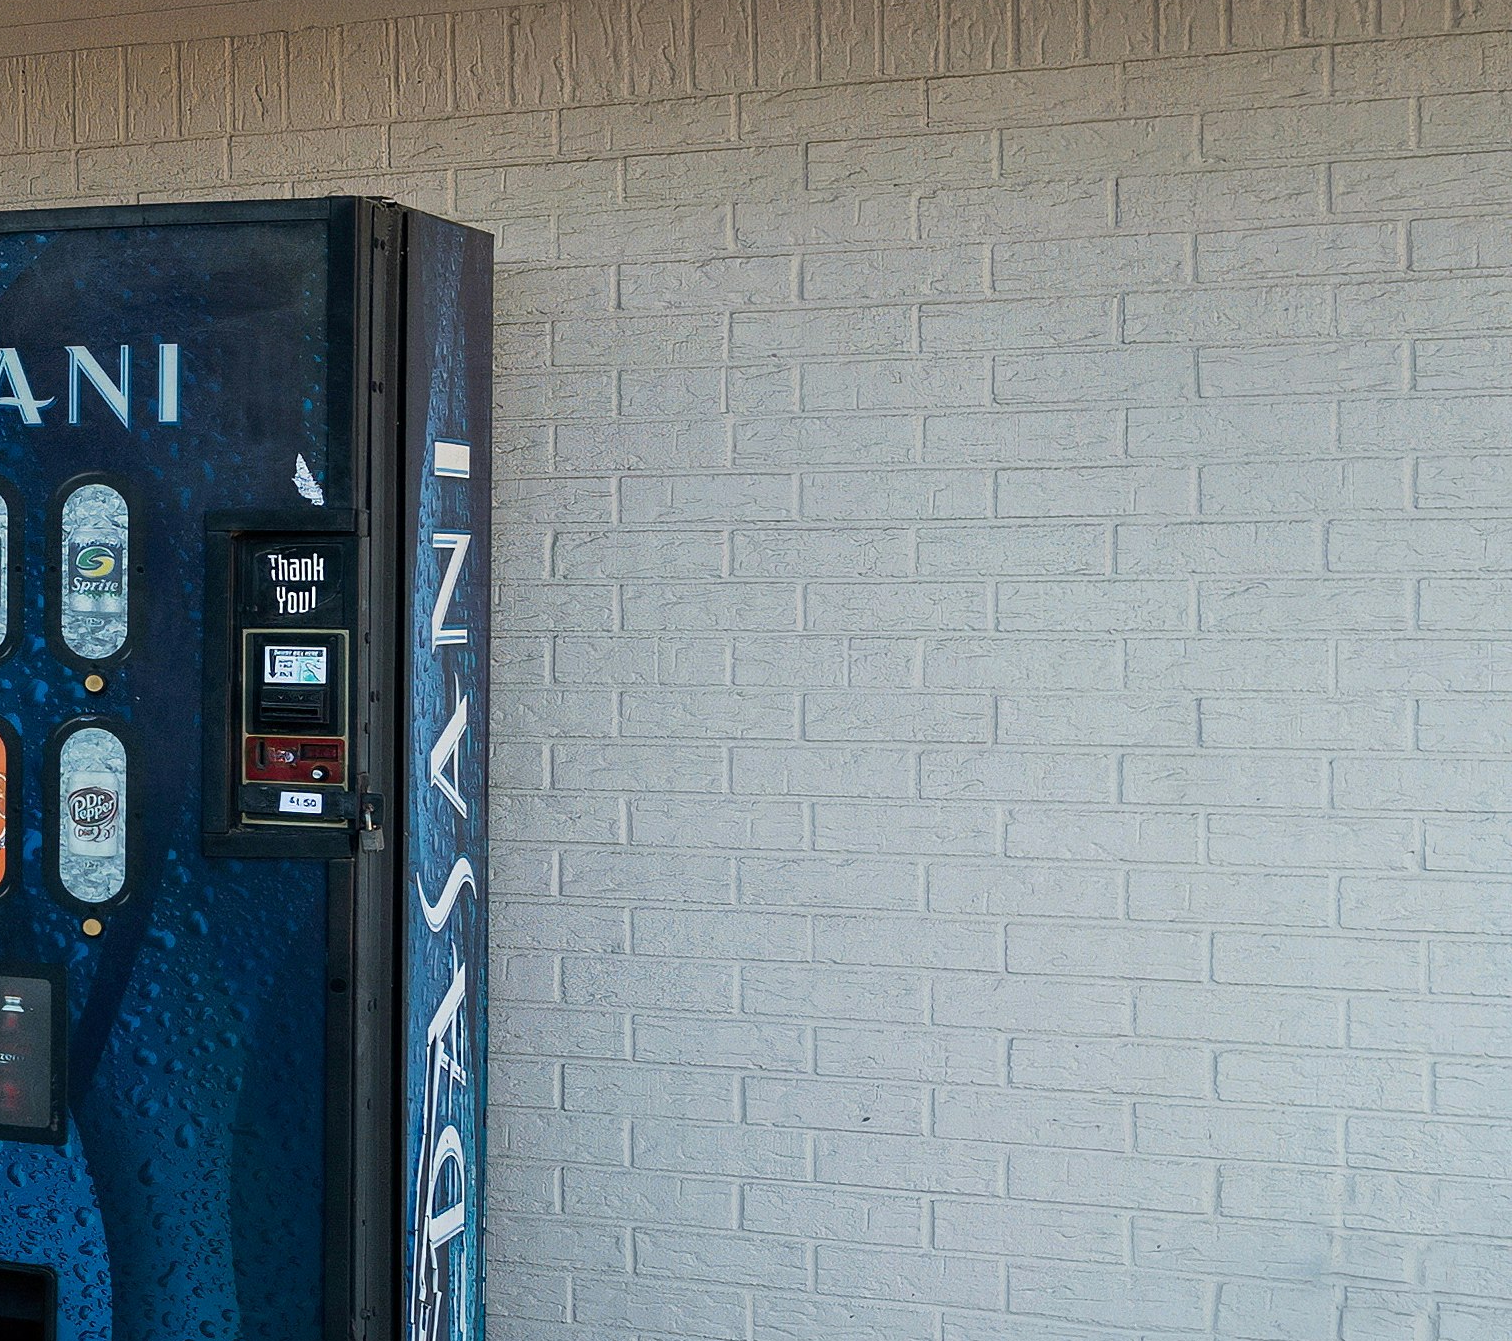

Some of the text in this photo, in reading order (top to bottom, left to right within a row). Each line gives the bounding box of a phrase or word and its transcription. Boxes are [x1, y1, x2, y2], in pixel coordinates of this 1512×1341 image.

[268, 553, 324, 581] Thank
[71, 576, 119, 595] Sprite
[74, 796, 114, 821] Pepper
[86, 793, 105, 807] Dr
[416, 439, 476, 1249] DASANI
